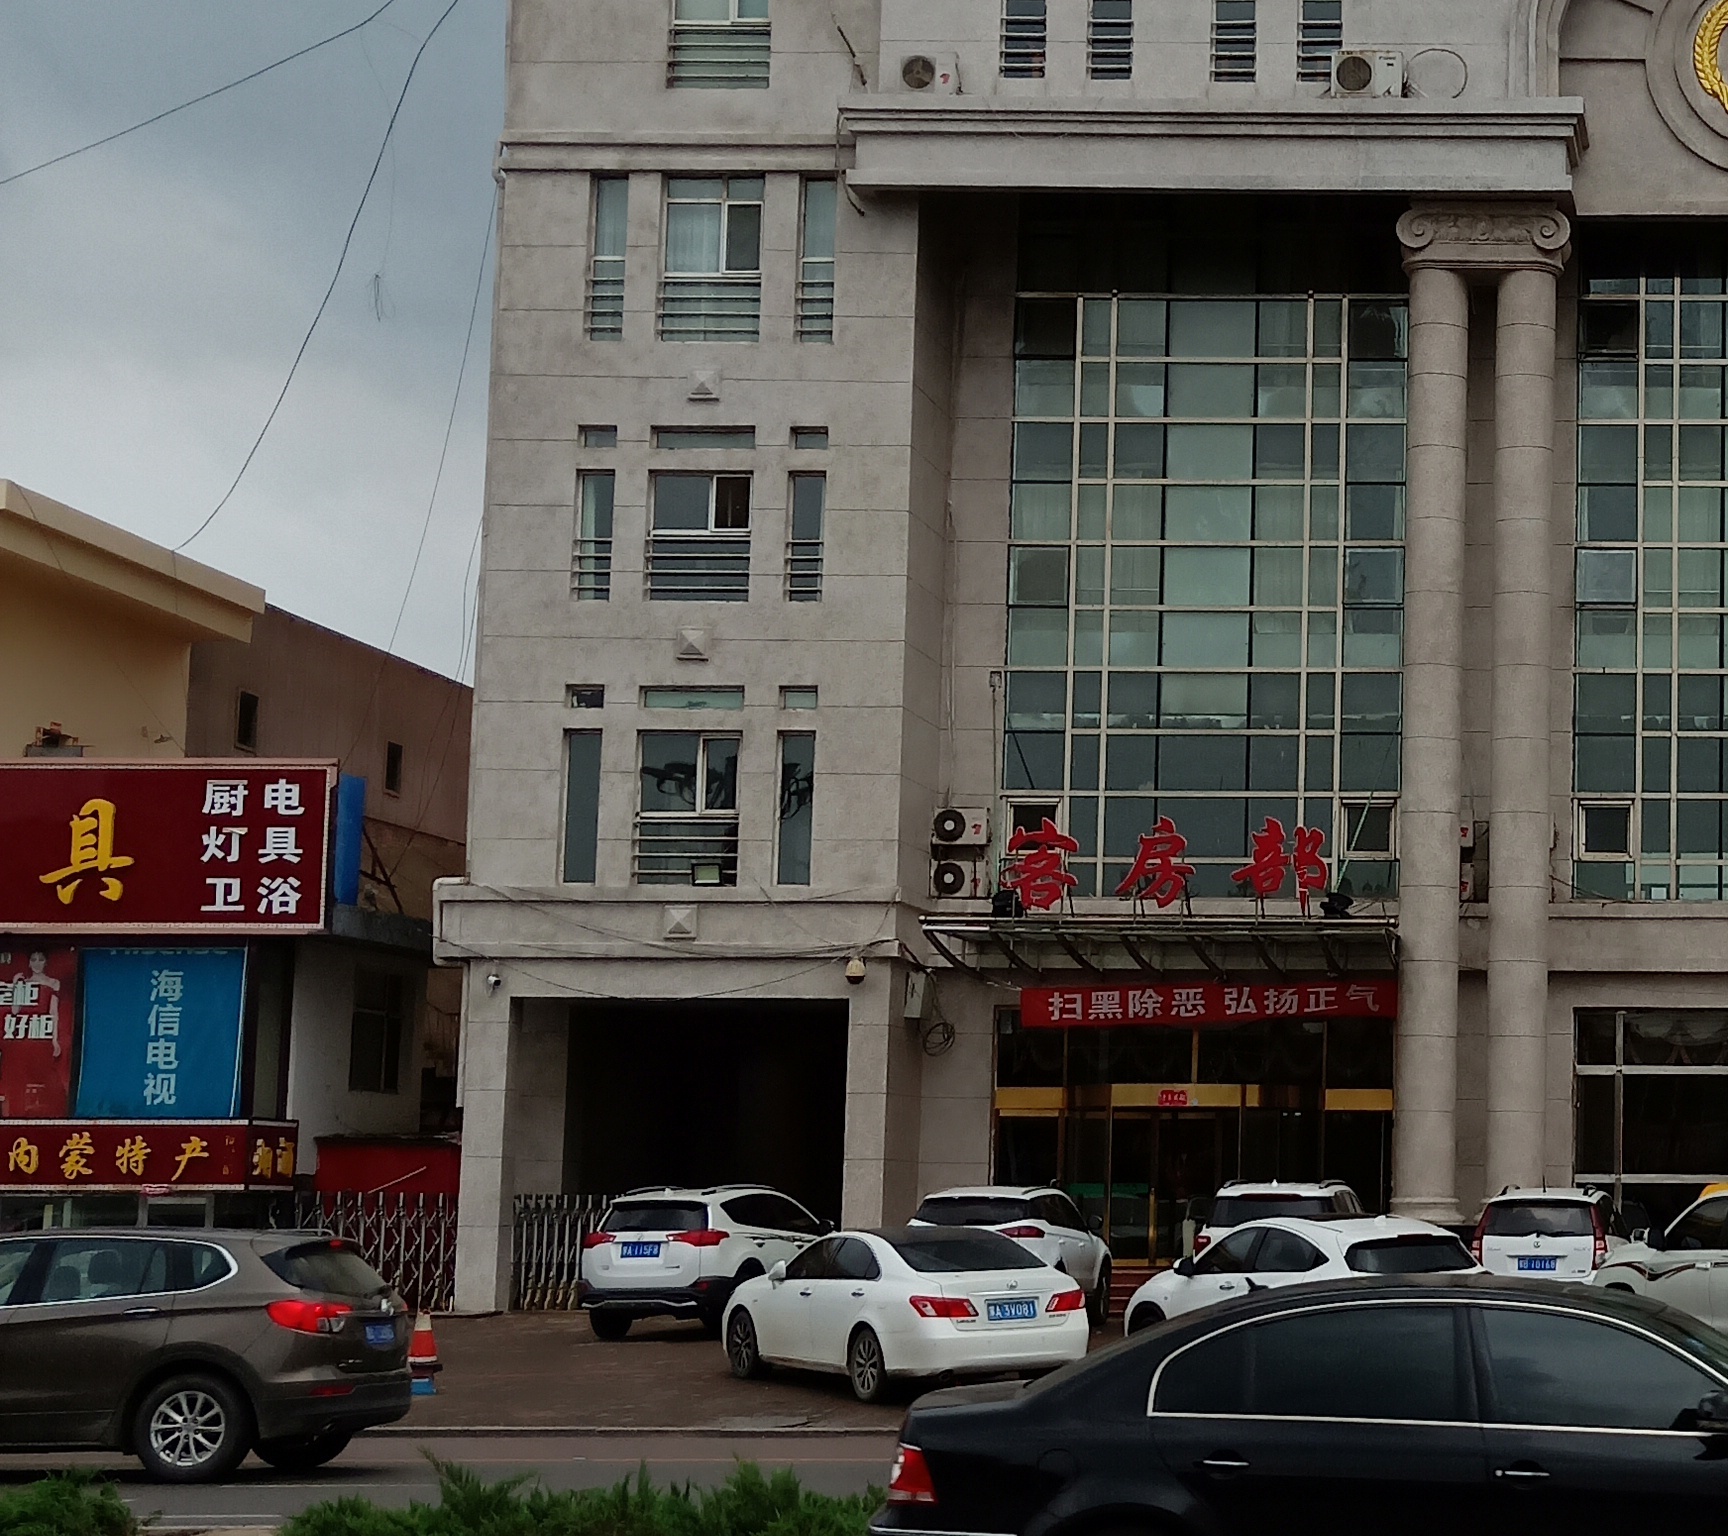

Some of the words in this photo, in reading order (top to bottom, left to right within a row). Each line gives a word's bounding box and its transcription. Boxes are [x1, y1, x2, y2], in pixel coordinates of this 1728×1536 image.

[202, 778, 305, 816] 厨电
[39, 797, 135, 905] 具
[200, 826, 303, 864] 灯具
[1000, 816, 1328, 910] 客房部
[200, 876, 302, 914] 卫浴
[1048, 986, 1205, 1021] 扫黑除恶
[1224, 982, 1380, 1015] 弘扬正气
[143, 969, 184, 1106] 海信电视
[8, 1131, 209, 1182] 内蒙特产
